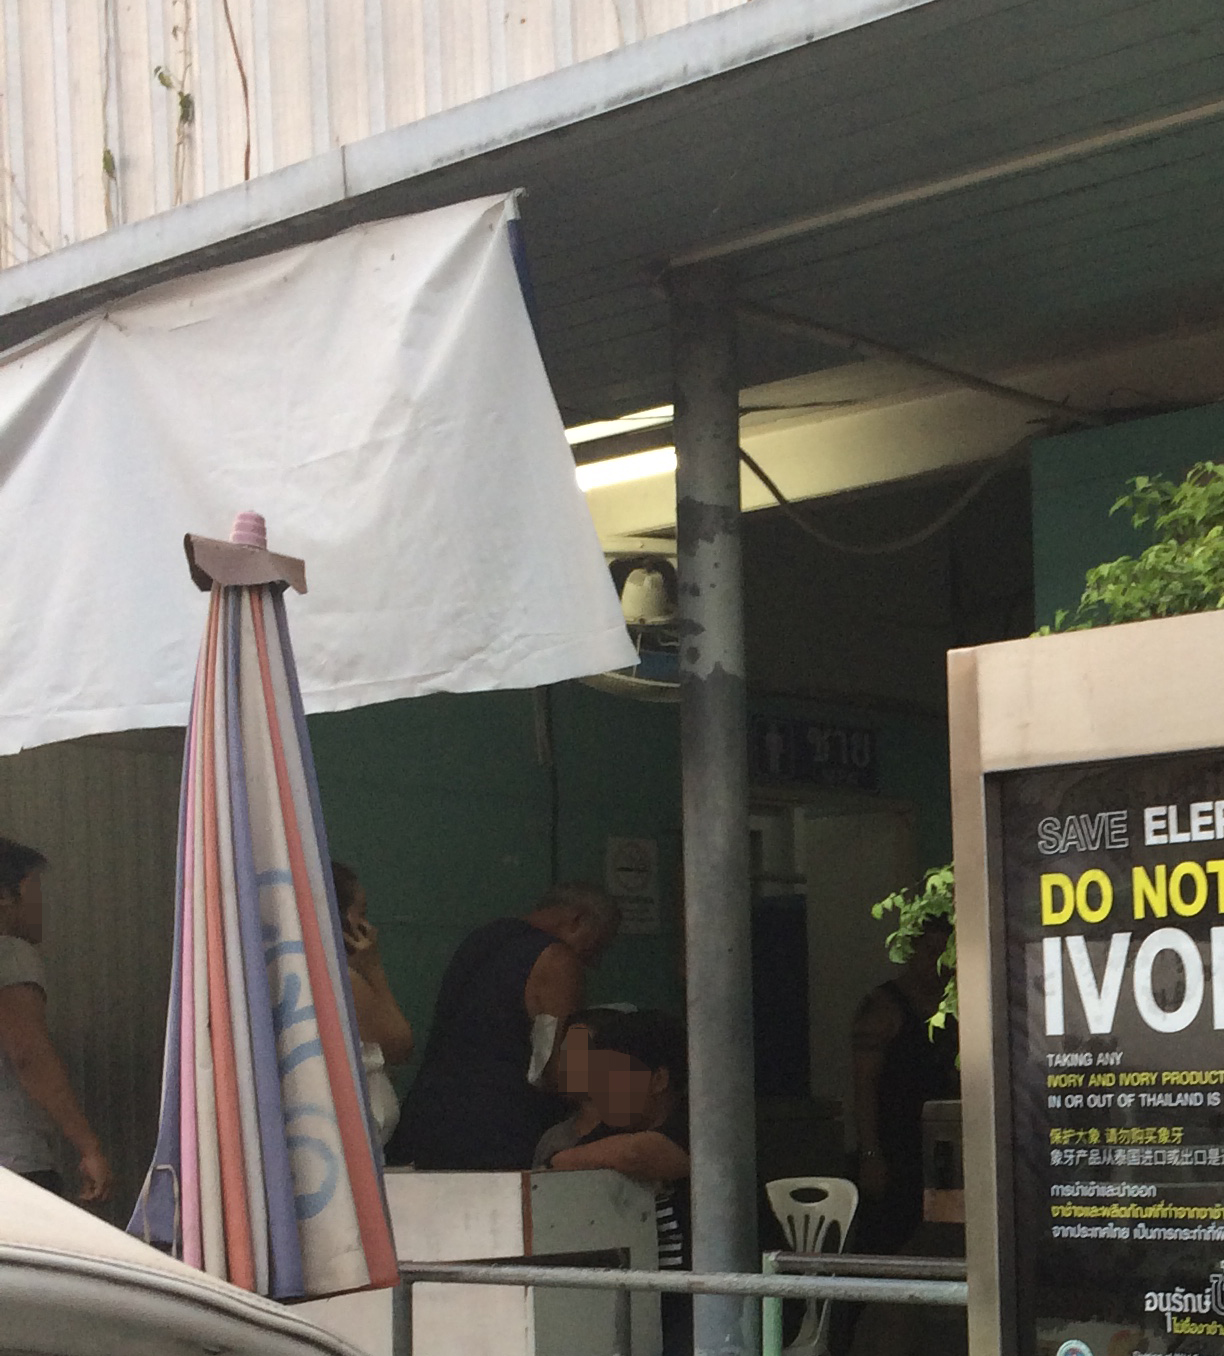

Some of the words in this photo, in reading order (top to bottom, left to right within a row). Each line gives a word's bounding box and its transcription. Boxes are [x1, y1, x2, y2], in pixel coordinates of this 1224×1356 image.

[1037, 809, 1129, 855] SAVE
[1040, 868, 1114, 926] DO
[1046, 1053, 1093, 1067] TAKING
[1096, 1051, 1123, 1066] ANY
[1047, 1073, 1084, 1088] IVORY
[1088, 1073, 1116, 1087] AND
[1119, 1072, 1157, 1087] IVORY
[1048, 1095, 1061, 1109] IN
[1064, 1094, 1084, 1108] OR
[1087, 1093, 1114, 1108] OUT
[1117, 1093, 1136, 1107] OF
[1138, 1092, 1203, 1107] THAILAND
[1206, 1092, 1221, 1106] IS
